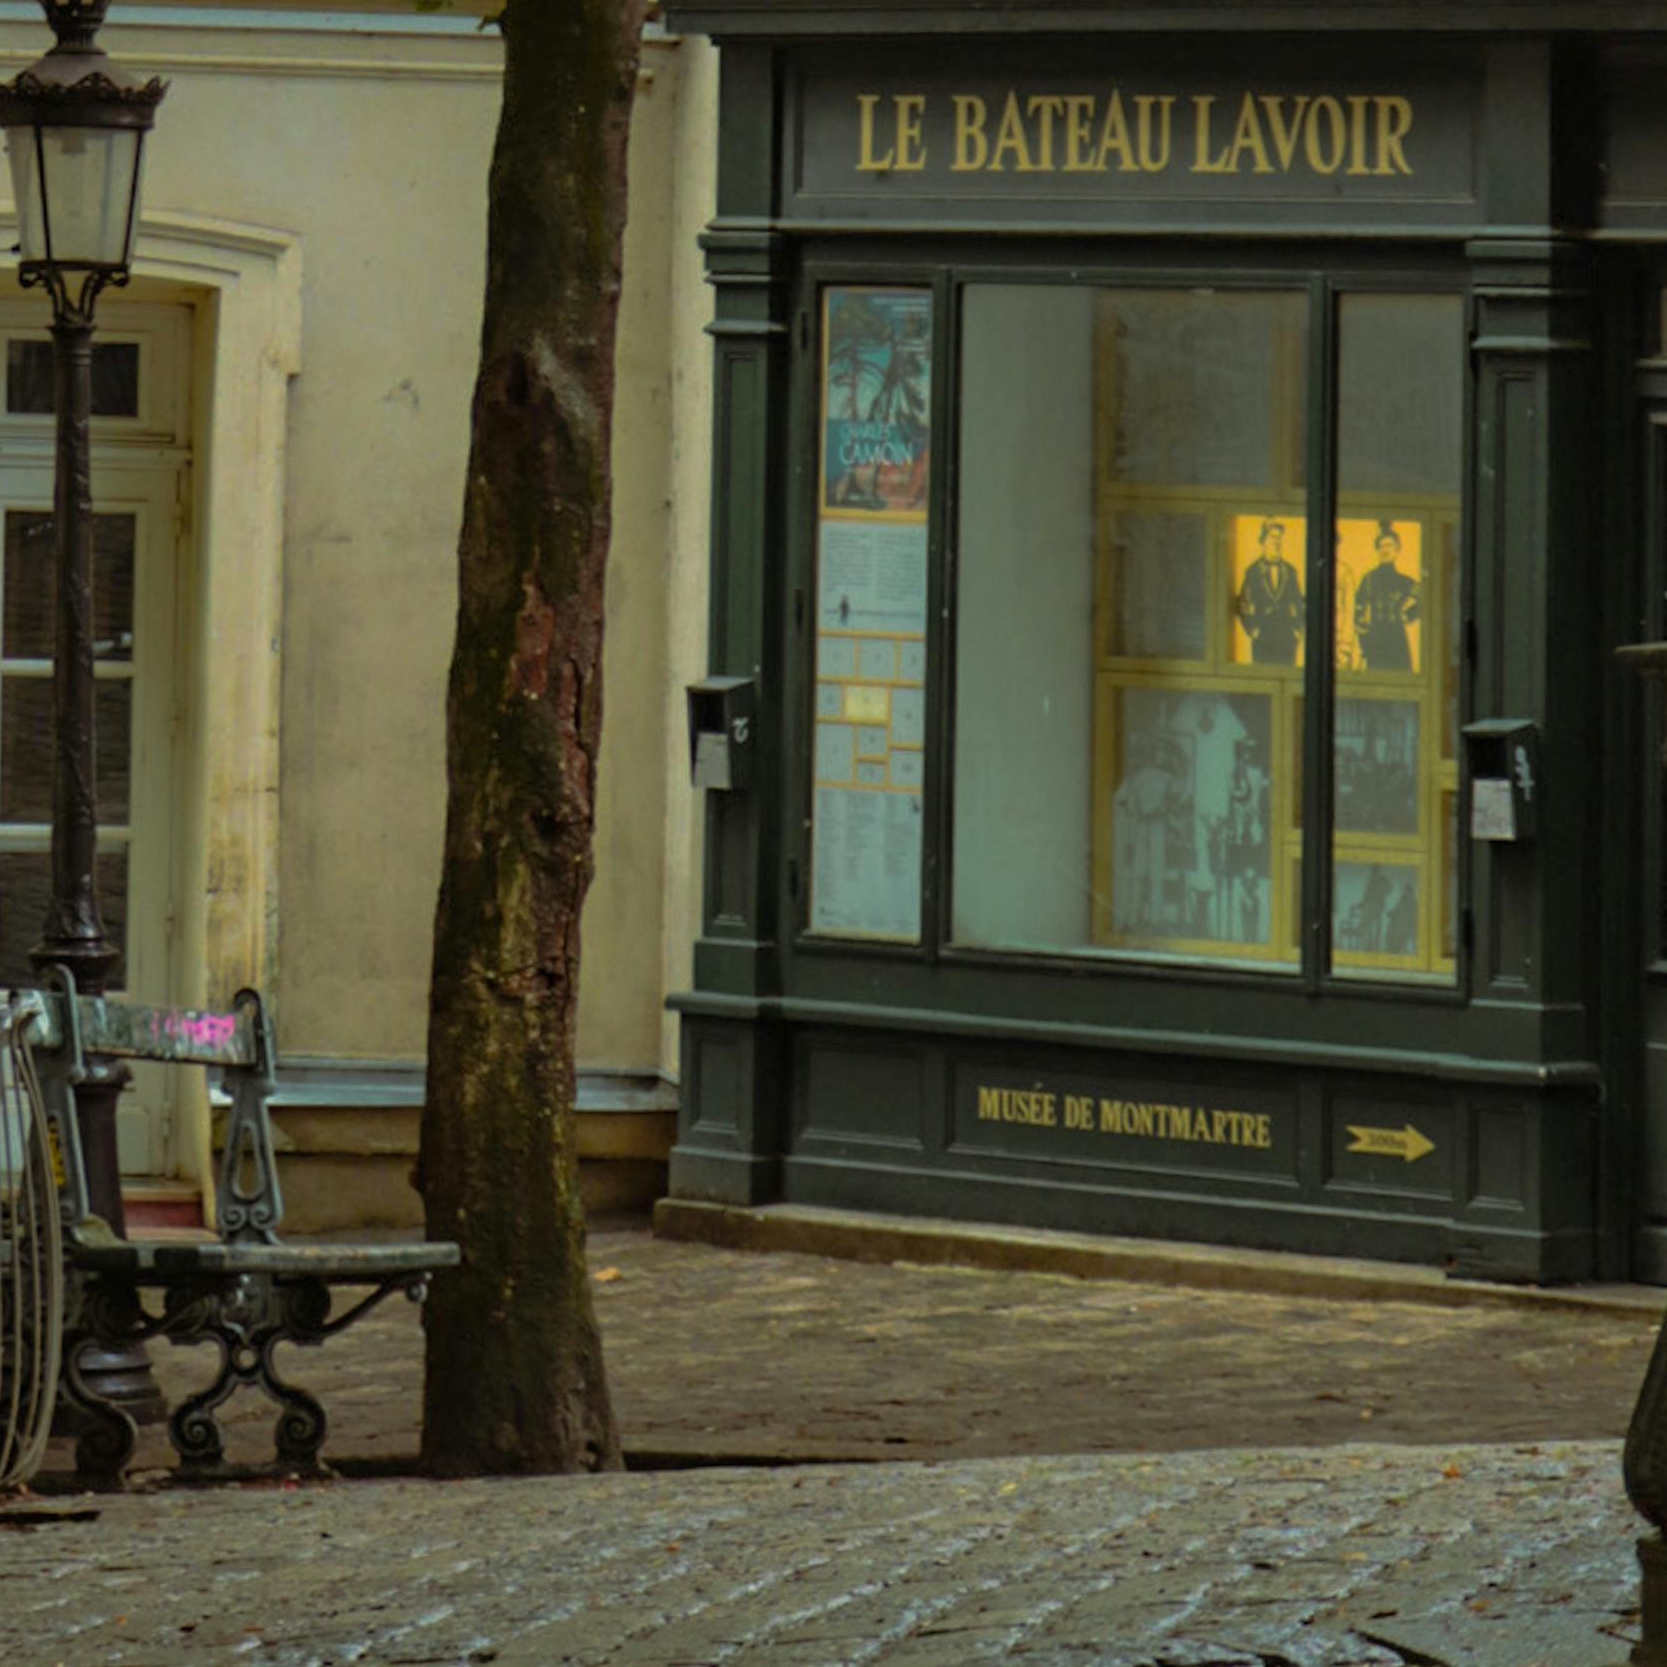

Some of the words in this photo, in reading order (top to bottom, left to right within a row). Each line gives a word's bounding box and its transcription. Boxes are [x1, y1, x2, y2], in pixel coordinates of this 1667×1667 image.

[856, 94, 926, 171] LE
[950, 89, 1176, 172] BATEAU
[1189, 91, 1414, 175] LAVOIR
[839, 442, 914, 465] CAMOIN
[978, 1083, 1056, 1125] MUSÉE
[1063, 1095, 1094, 1131] DE
[1101, 1098, 1272, 1148] MONTMARTRE
